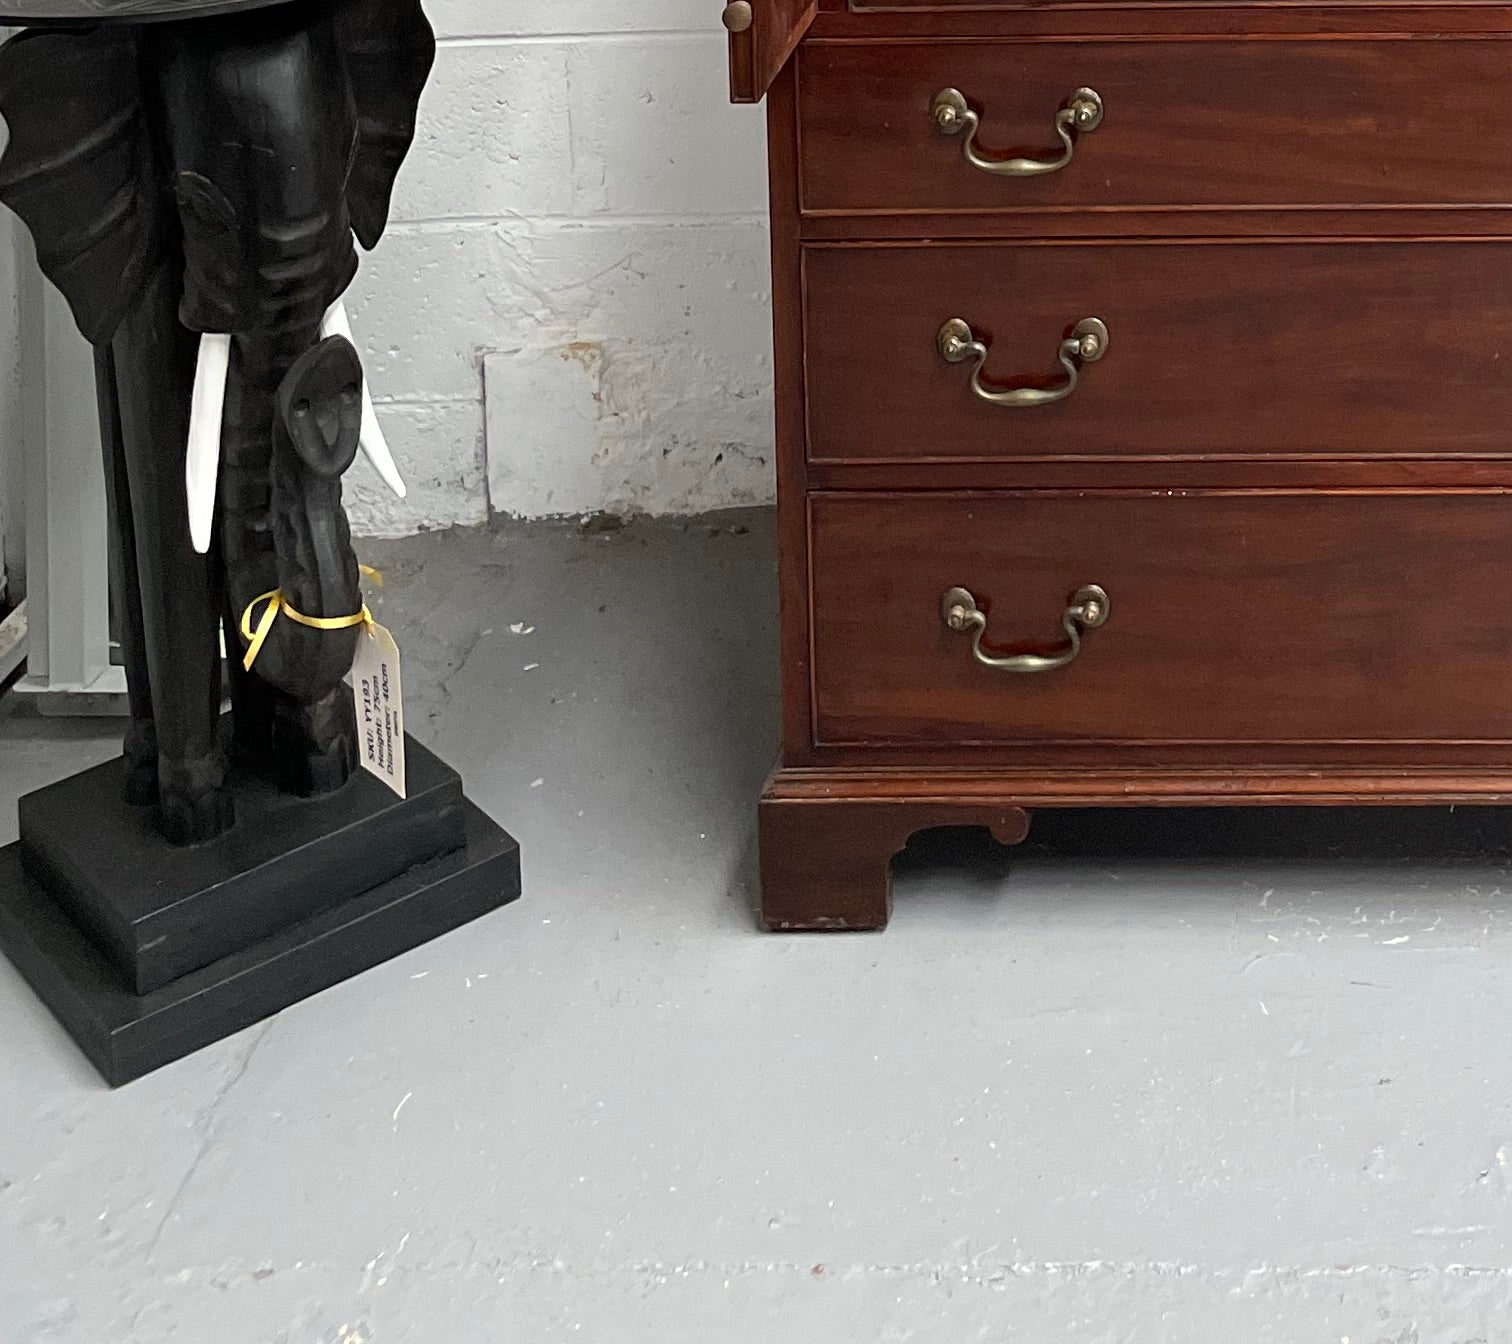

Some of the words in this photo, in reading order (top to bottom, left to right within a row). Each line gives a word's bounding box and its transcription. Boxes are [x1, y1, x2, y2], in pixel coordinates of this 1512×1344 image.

[372, 675, 382, 713] 75cm
[381, 663, 390, 703] 40cm
[373, 717, 385, 769] Height:
[383, 705, 394, 777] Diameter:
